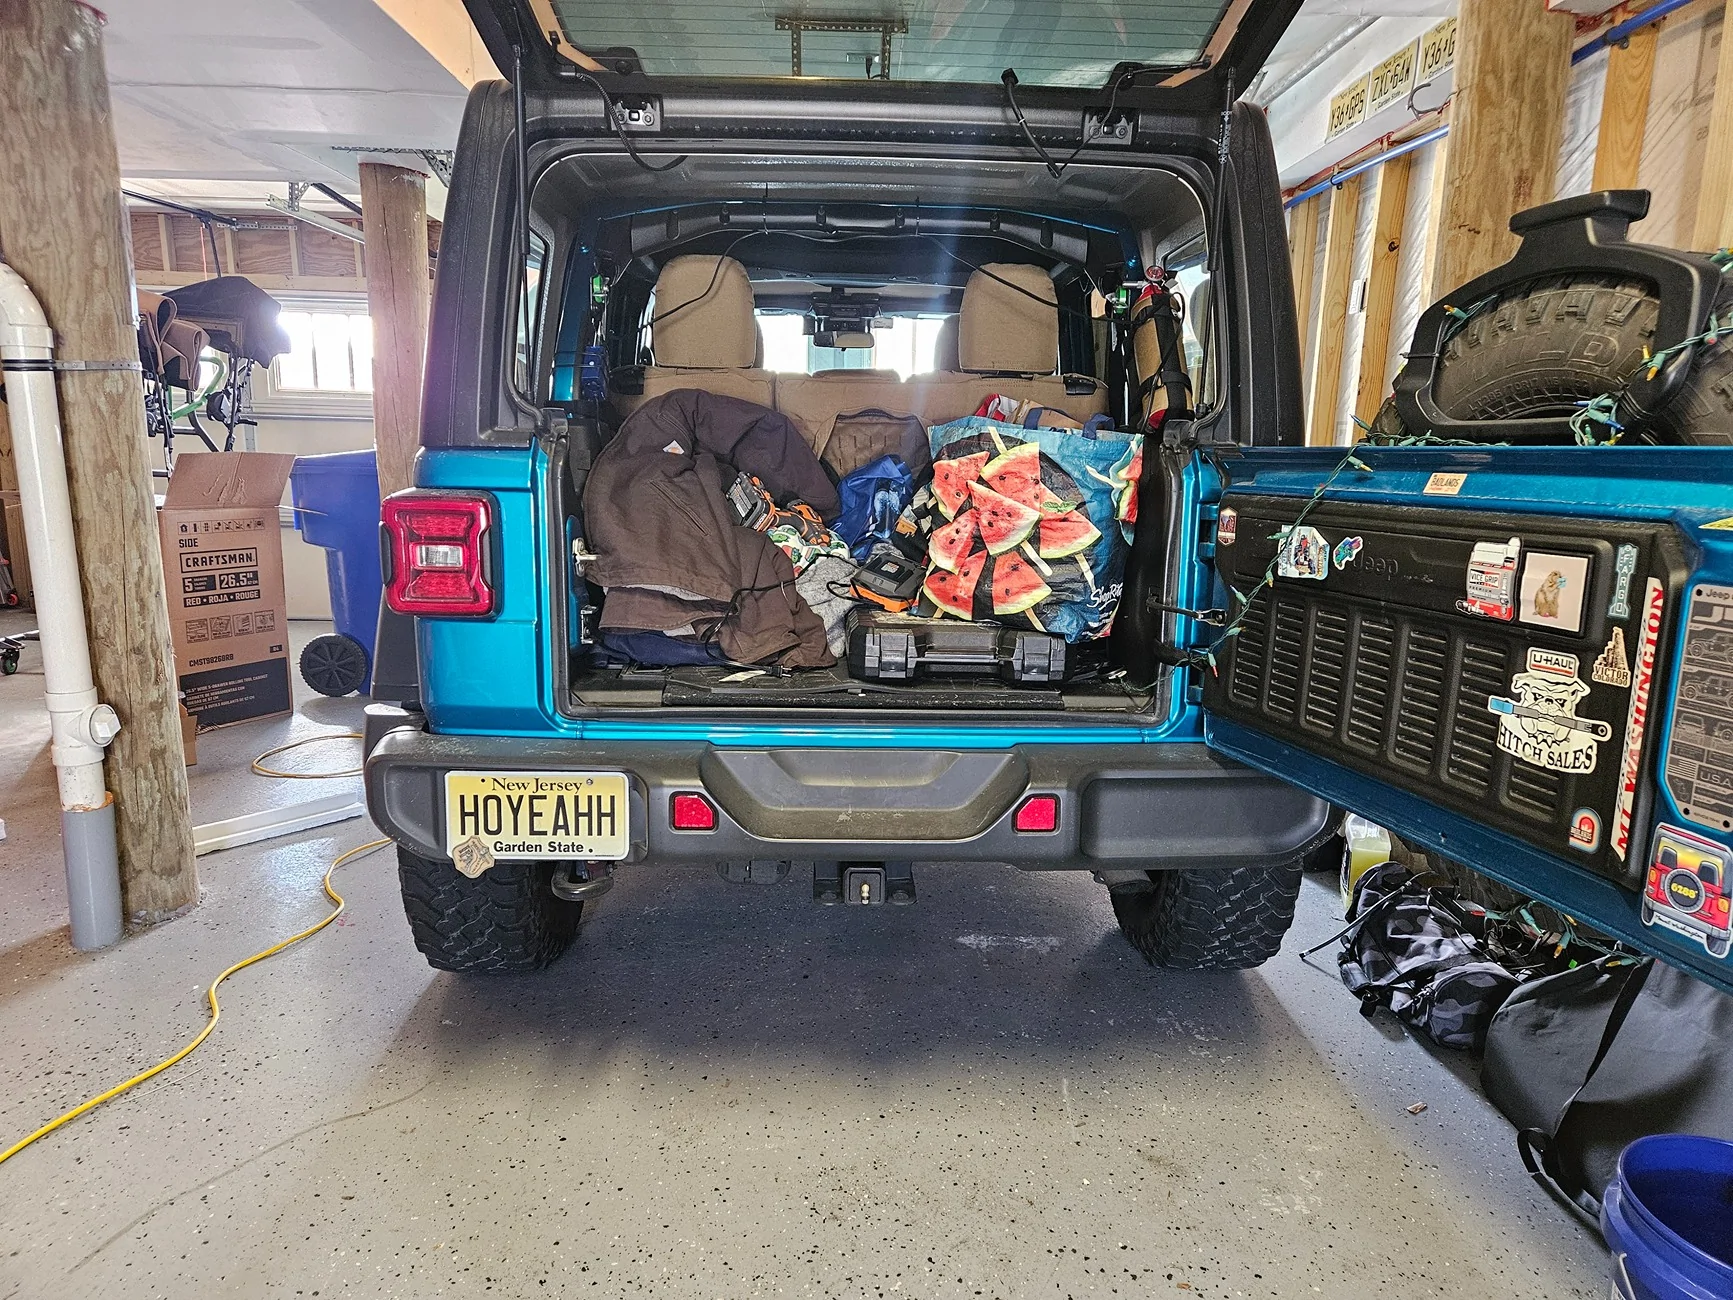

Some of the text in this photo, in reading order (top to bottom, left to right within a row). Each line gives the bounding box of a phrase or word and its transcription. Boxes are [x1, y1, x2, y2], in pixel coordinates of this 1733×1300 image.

[179, 538, 199, 549] SIDE
[185, 552, 253, 568] CRAFTSMAN
[184, 578, 193, 592] 5
[1470, 572, 1499, 584] VICE GRIP
[1615, 553, 1631, 613] FARGO
[186, 591, 259, 606] RED ROJA ROUGE
[1705, 588, 1730, 601] Jeep
[1593, 674, 1628, 686] COLORADO
[1594, 665, 1629, 680] VICTOR
[1499, 723, 1594, 770] HITCH SALES
[491, 777, 583, 794] New Jersey
[459, 794, 616, 836] HOYEAHH
[493, 841, 584, 853] Garden State
